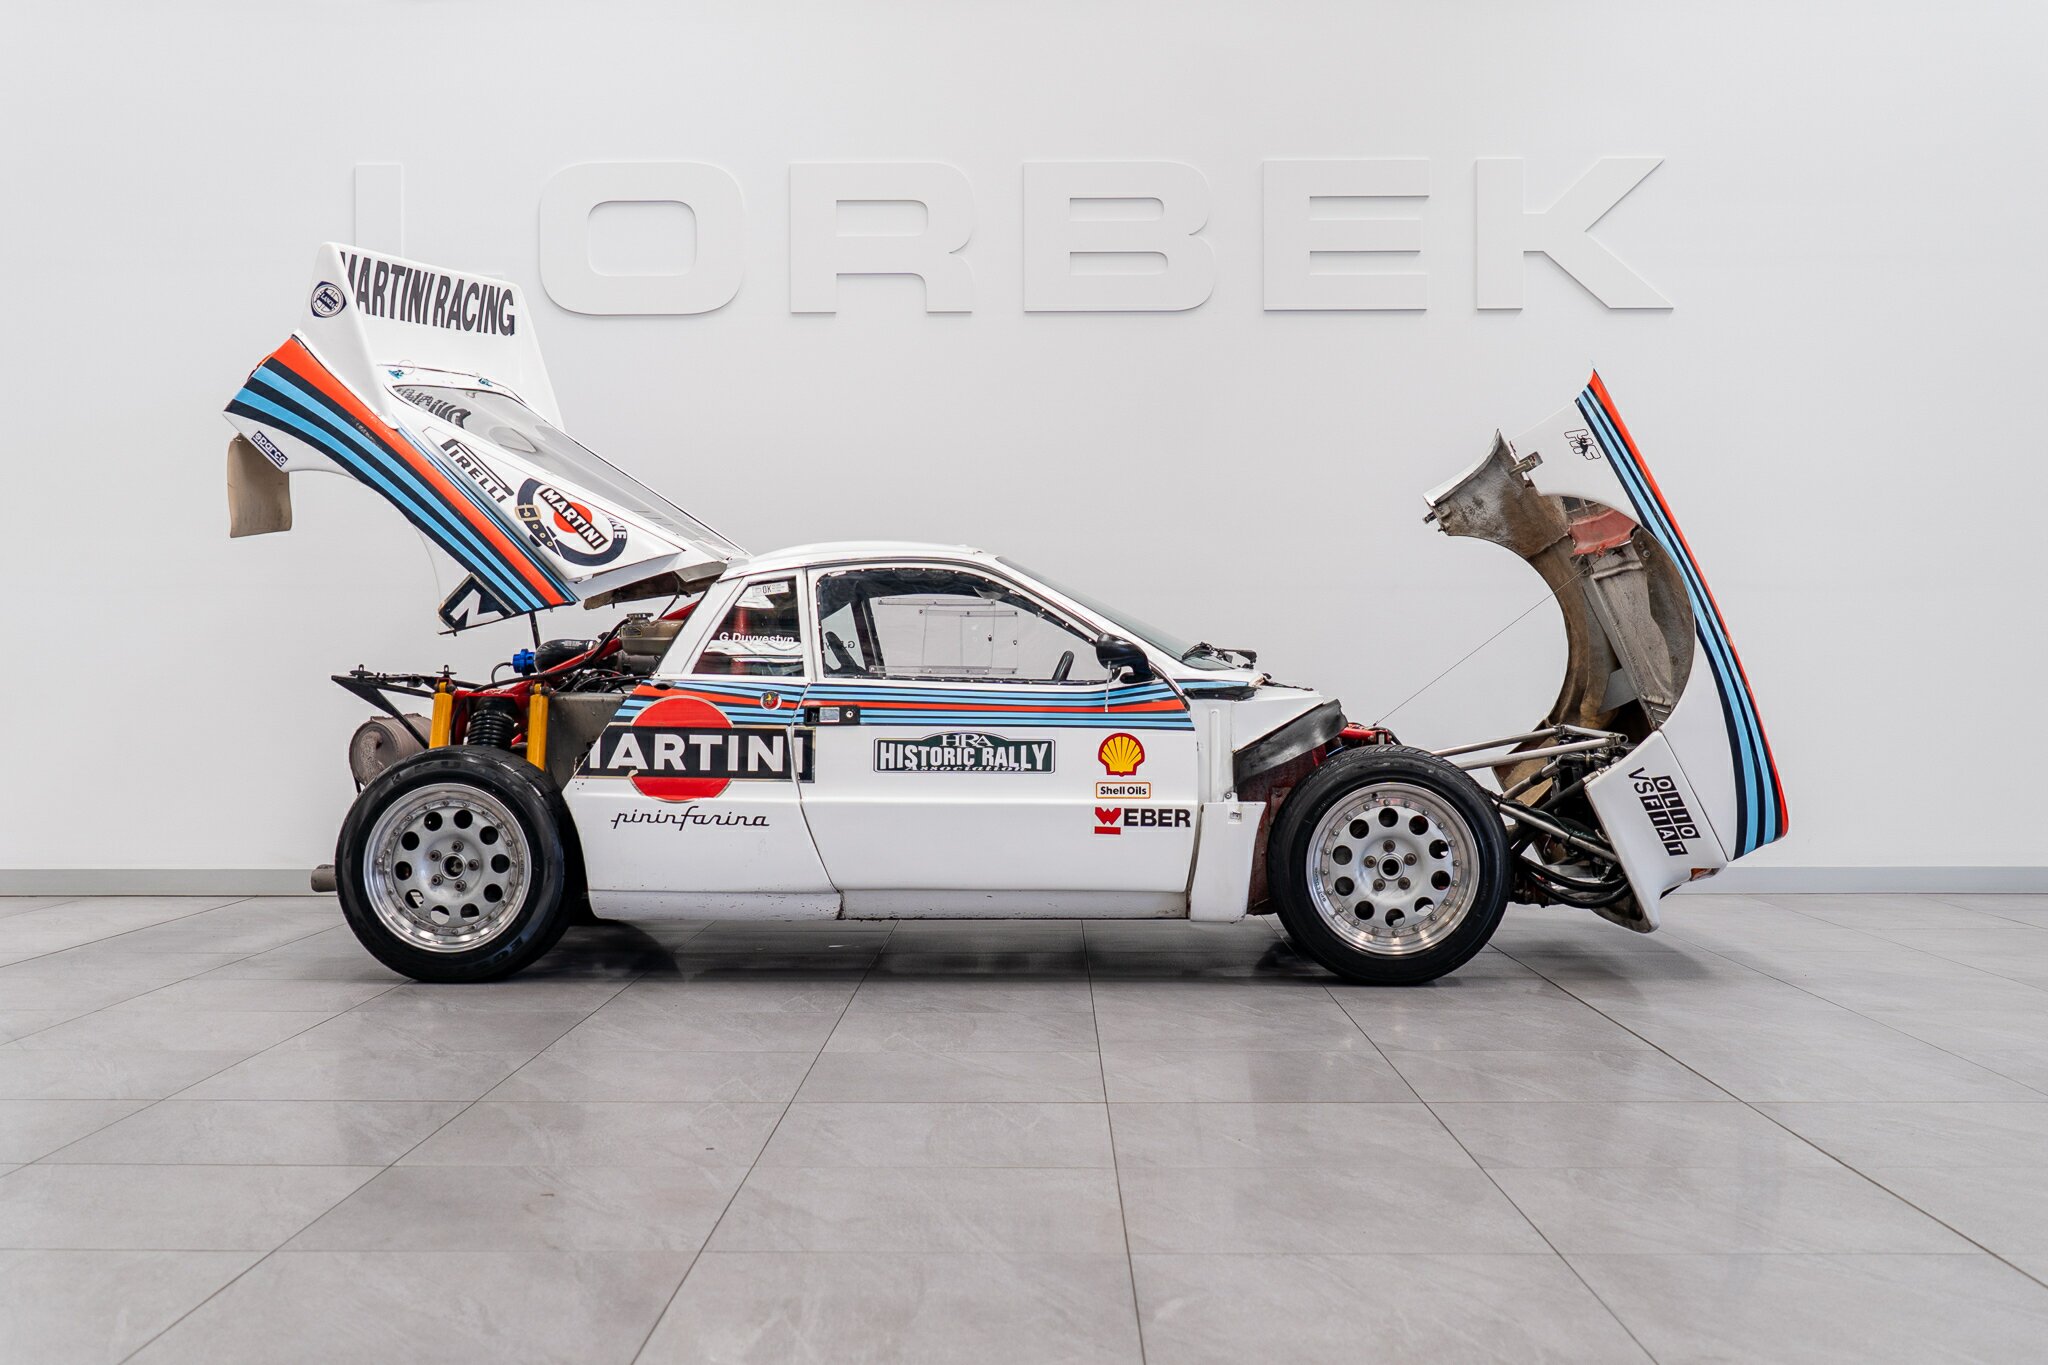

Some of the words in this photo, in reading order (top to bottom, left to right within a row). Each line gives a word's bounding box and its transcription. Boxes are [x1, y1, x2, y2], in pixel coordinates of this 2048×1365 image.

[432, 275, 516, 336] RACING
[252, 431, 287, 465] sparco
[440, 438, 515, 503] PIRELLI
[542, 488, 605, 547] MARTINI
[879, 742, 975, 770] HISTORIC
[981, 743, 1049, 771] RALLY
[939, 733, 995, 748] HRA
[1100, 785, 1125, 795] Shell
[1127, 785, 1147, 795] Oils
[611, 806, 770, 831] pininfarina
[1094, 806, 1192, 829] WEBER
[1642, 796, 1686, 854] FIAT
[1655, 778, 1697, 838] OLIO
